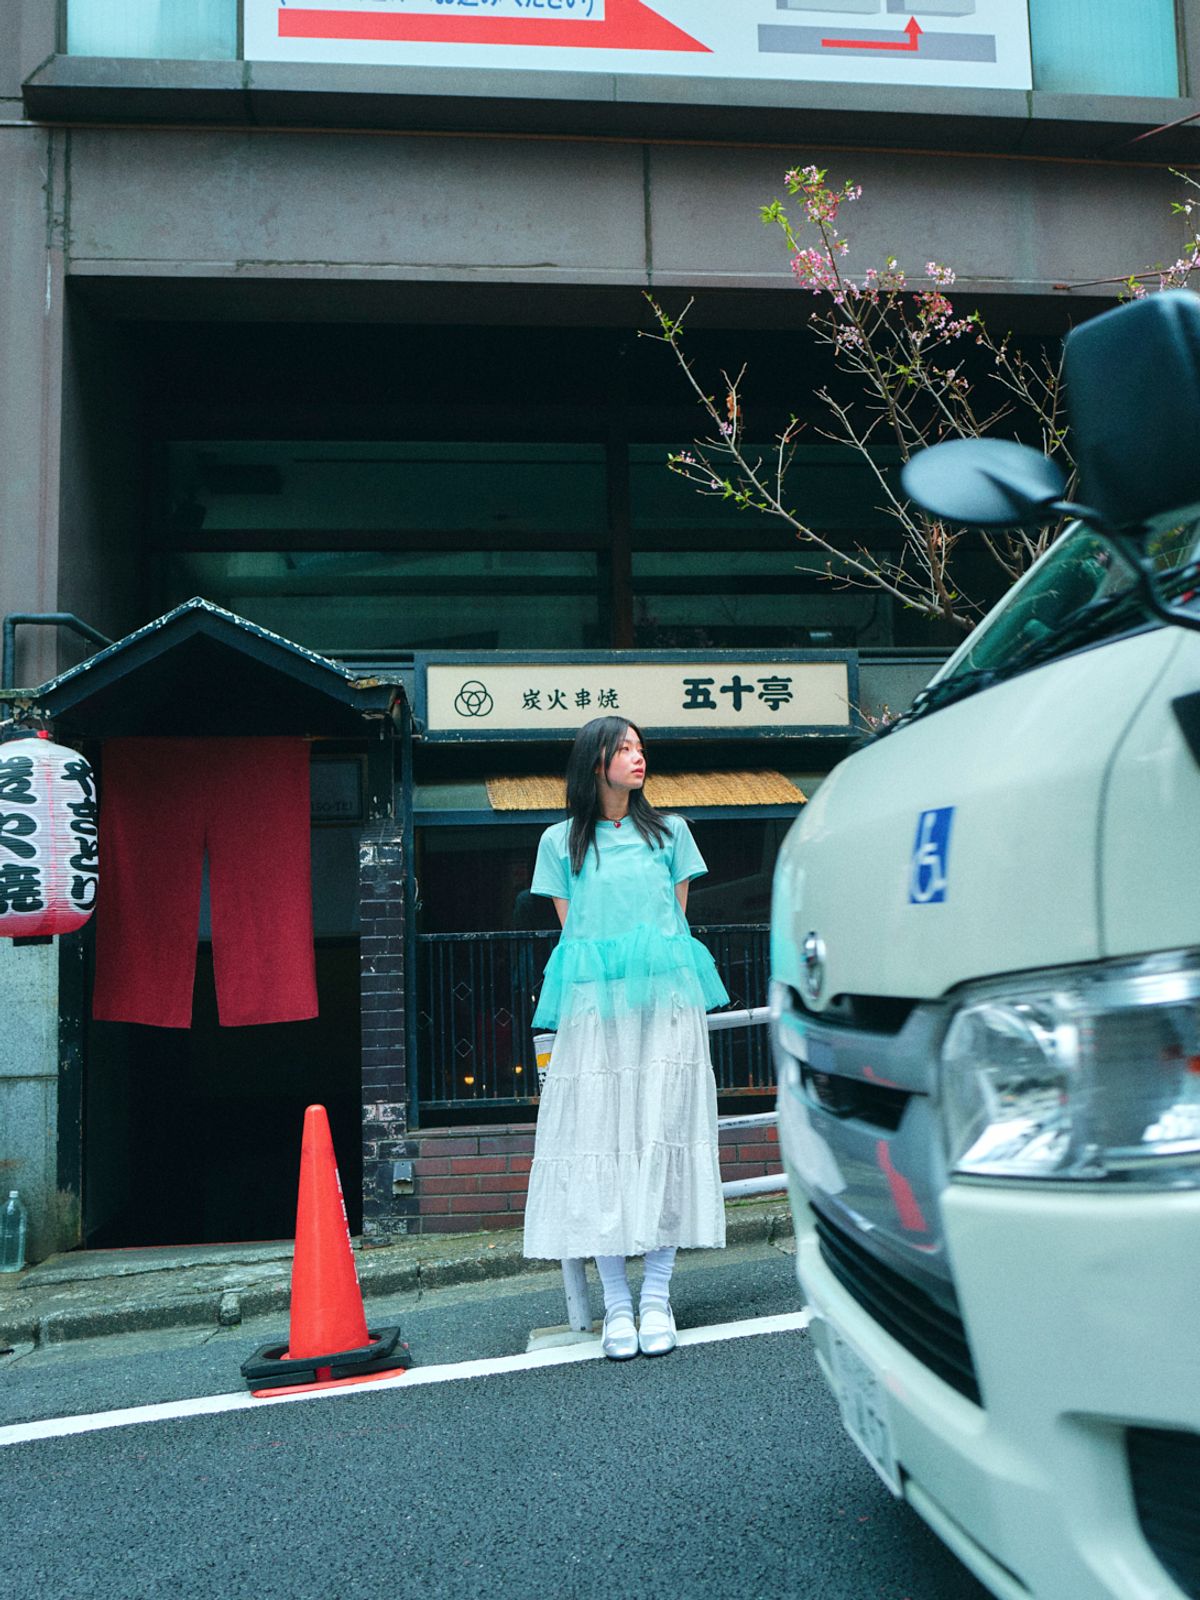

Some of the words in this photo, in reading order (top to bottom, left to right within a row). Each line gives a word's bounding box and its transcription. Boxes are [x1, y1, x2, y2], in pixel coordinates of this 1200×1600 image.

[522, 688, 620, 711] 炭火串焼
[682, 675, 793, 711] 五十亭
